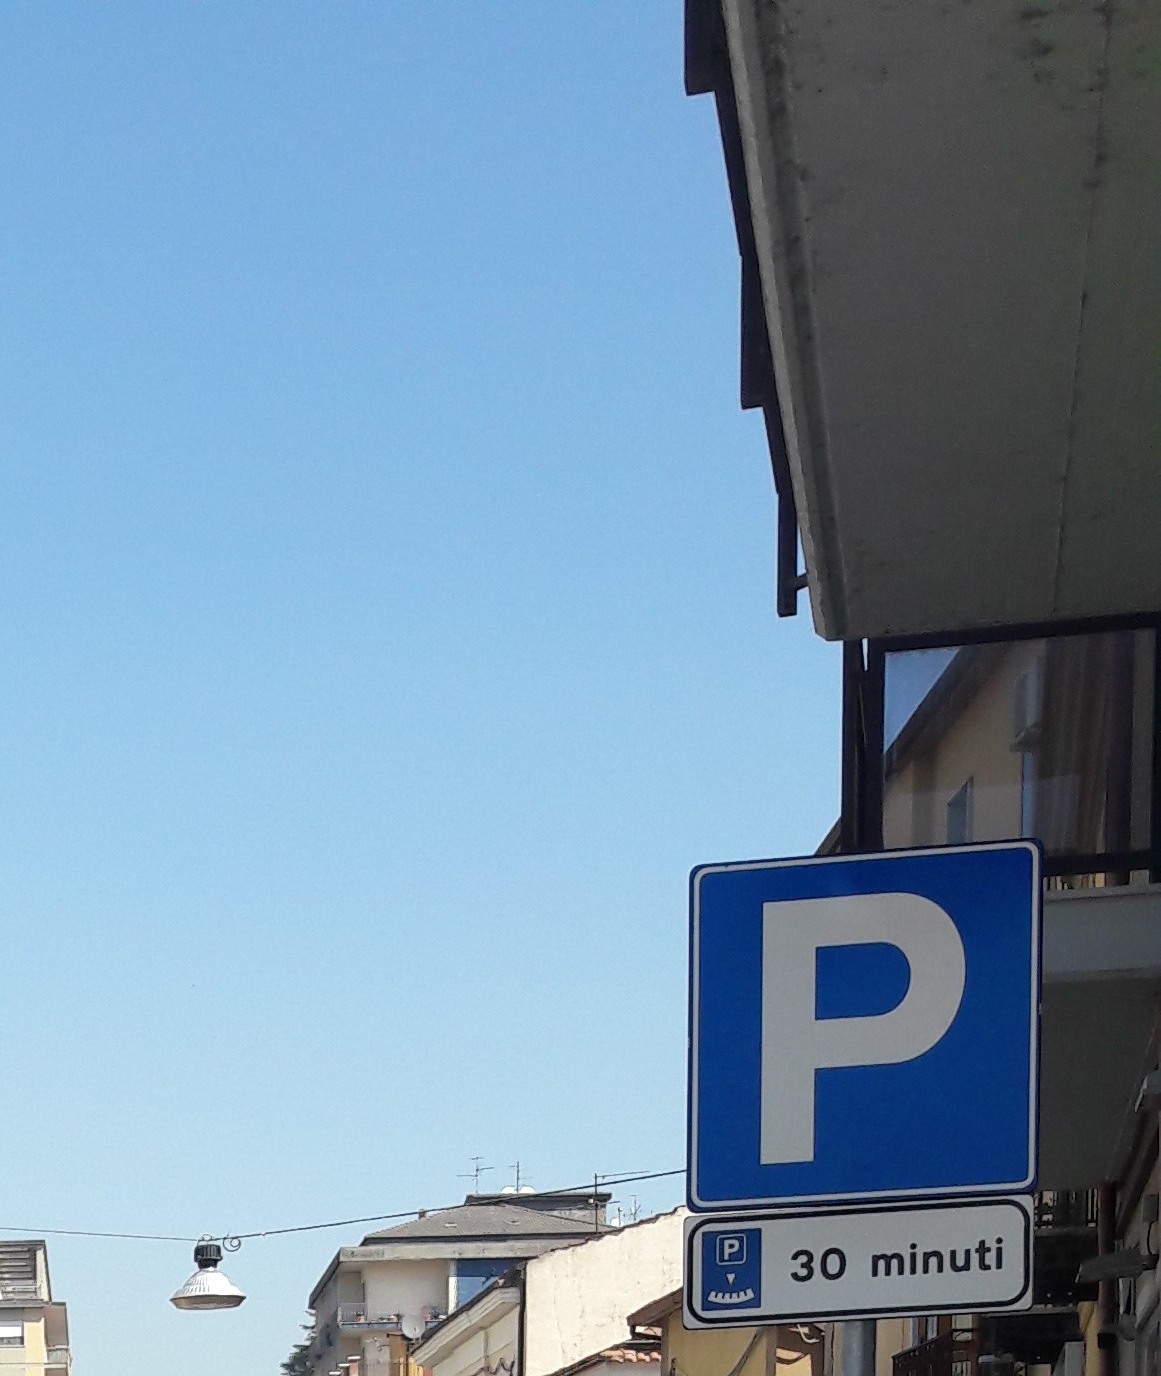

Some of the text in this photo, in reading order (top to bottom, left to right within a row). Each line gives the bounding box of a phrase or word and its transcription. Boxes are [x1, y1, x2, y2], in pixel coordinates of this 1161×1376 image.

[759, 892, 966, 1166] P
[723, 1237, 740, 1262] P
[790, 1236, 1004, 1283] 30 minuti
